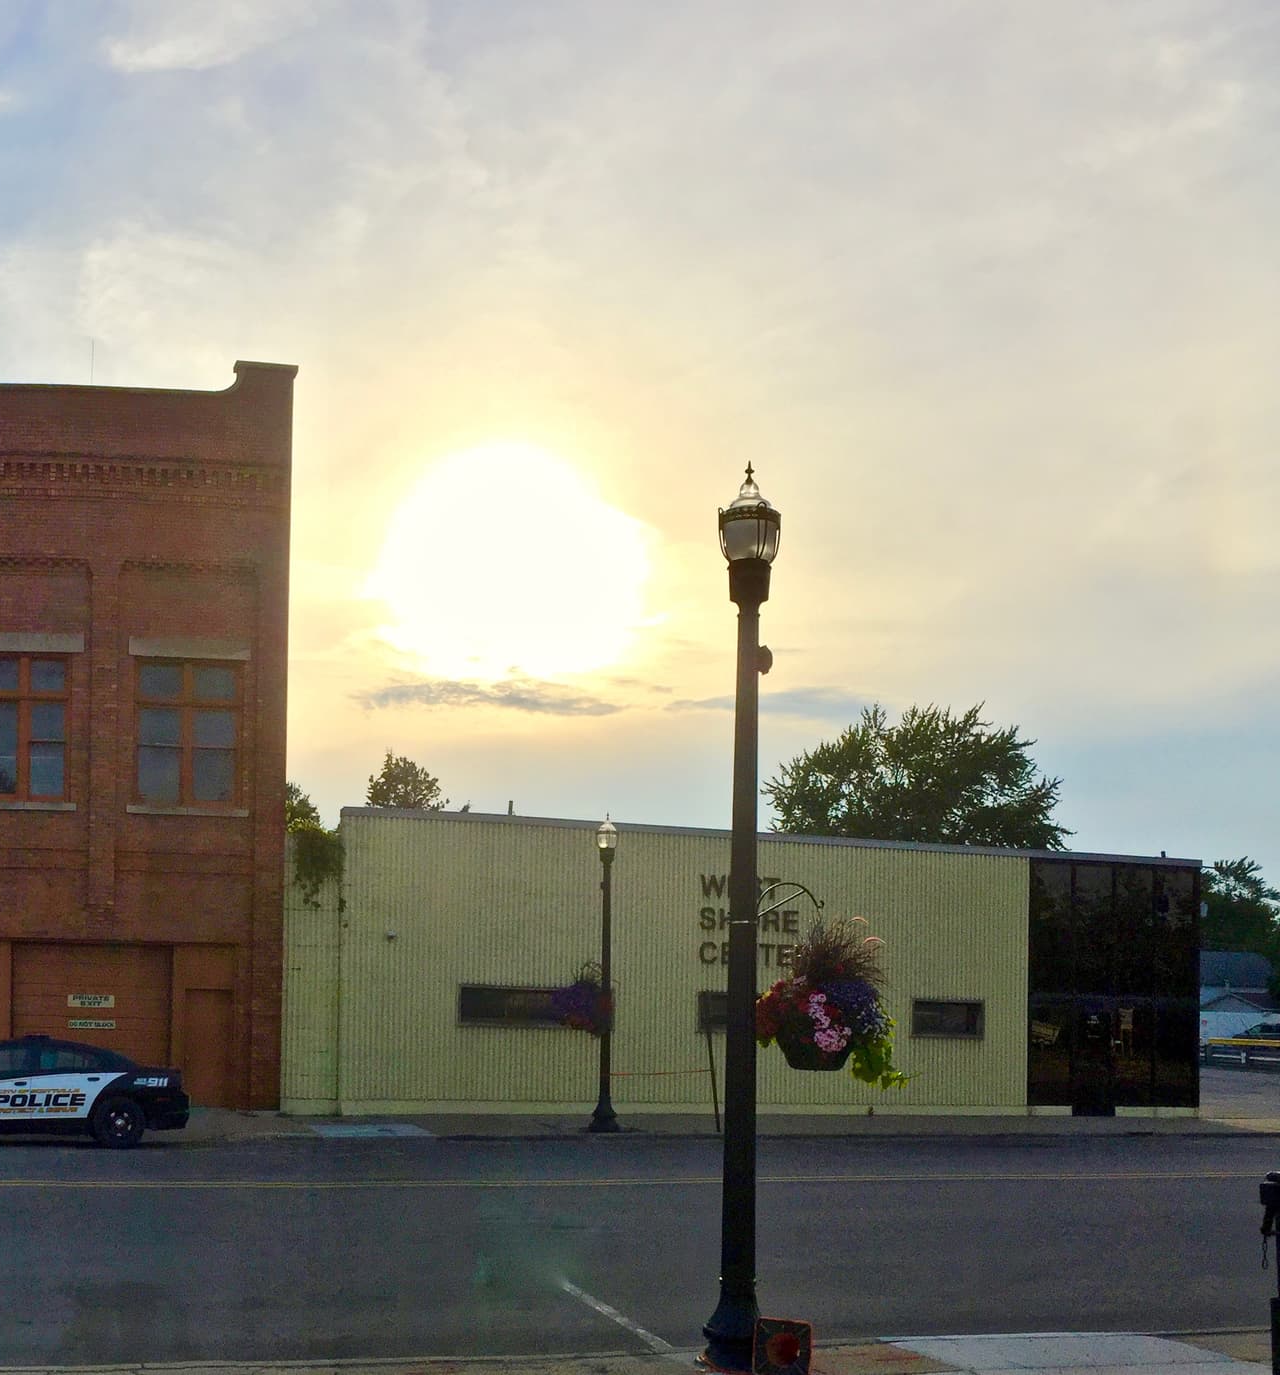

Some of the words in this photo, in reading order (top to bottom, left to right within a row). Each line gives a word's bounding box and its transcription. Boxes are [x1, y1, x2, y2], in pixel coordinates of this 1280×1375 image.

[700, 874, 781, 901] WT
[700, 907, 799, 932] SHRE
[700, 941, 795, 967] CETE
[147, 1077, 169, 1087] 911
